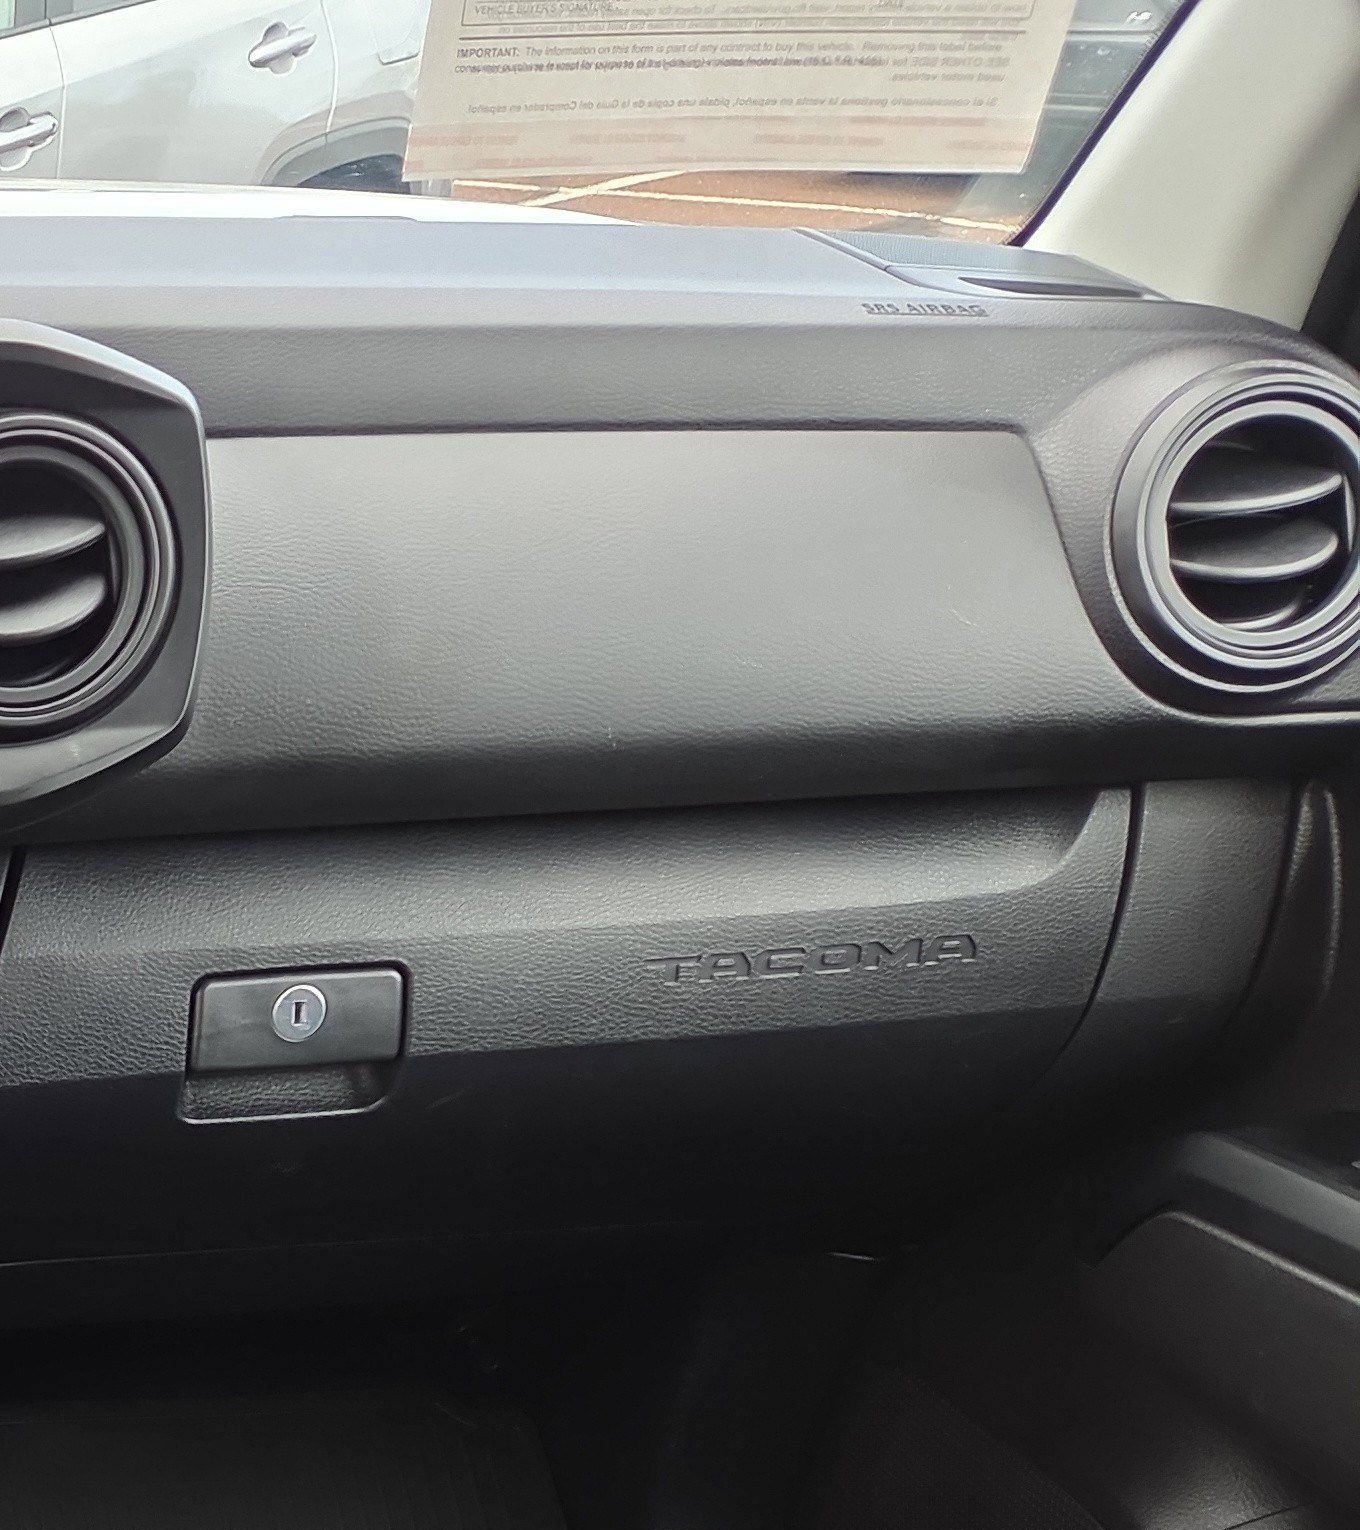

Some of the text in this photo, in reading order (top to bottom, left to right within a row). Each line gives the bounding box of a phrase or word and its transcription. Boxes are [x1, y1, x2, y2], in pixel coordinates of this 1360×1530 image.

[457, 47, 519, 58] IMPORTANT:
[526, 46, 542, 56] The
[906, 303, 989, 317] AIRBAG
[643, 933, 978, 987] TACOMA
